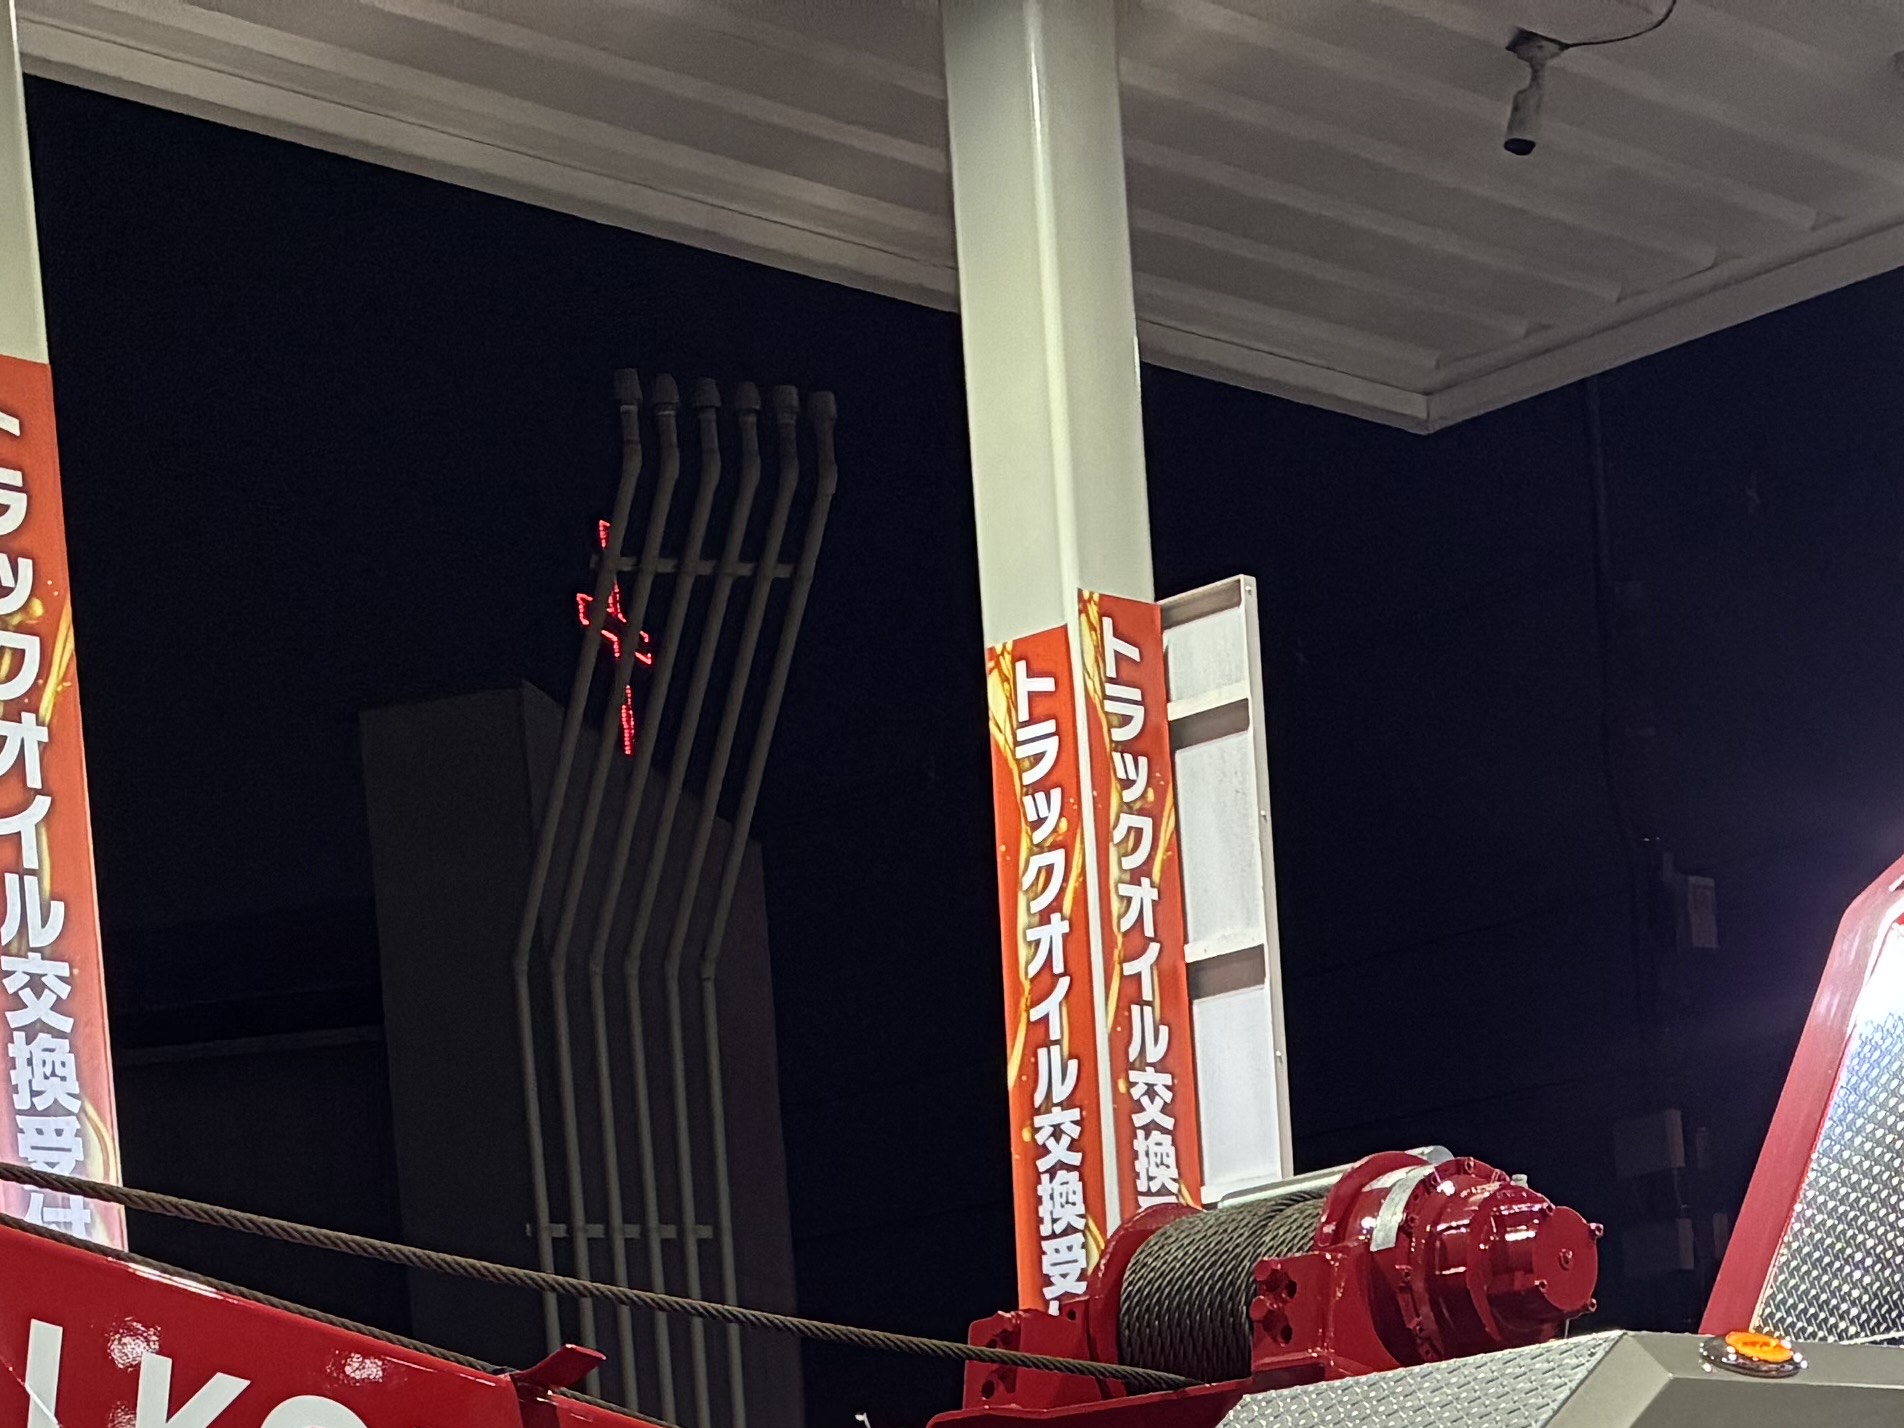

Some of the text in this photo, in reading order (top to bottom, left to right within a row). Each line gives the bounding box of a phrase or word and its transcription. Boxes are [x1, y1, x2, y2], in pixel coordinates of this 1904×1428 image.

[1015, 660, 1088, 1316] トラックオイル交換受
[1101, 616, 1179, 1208] トラックオイル交換
